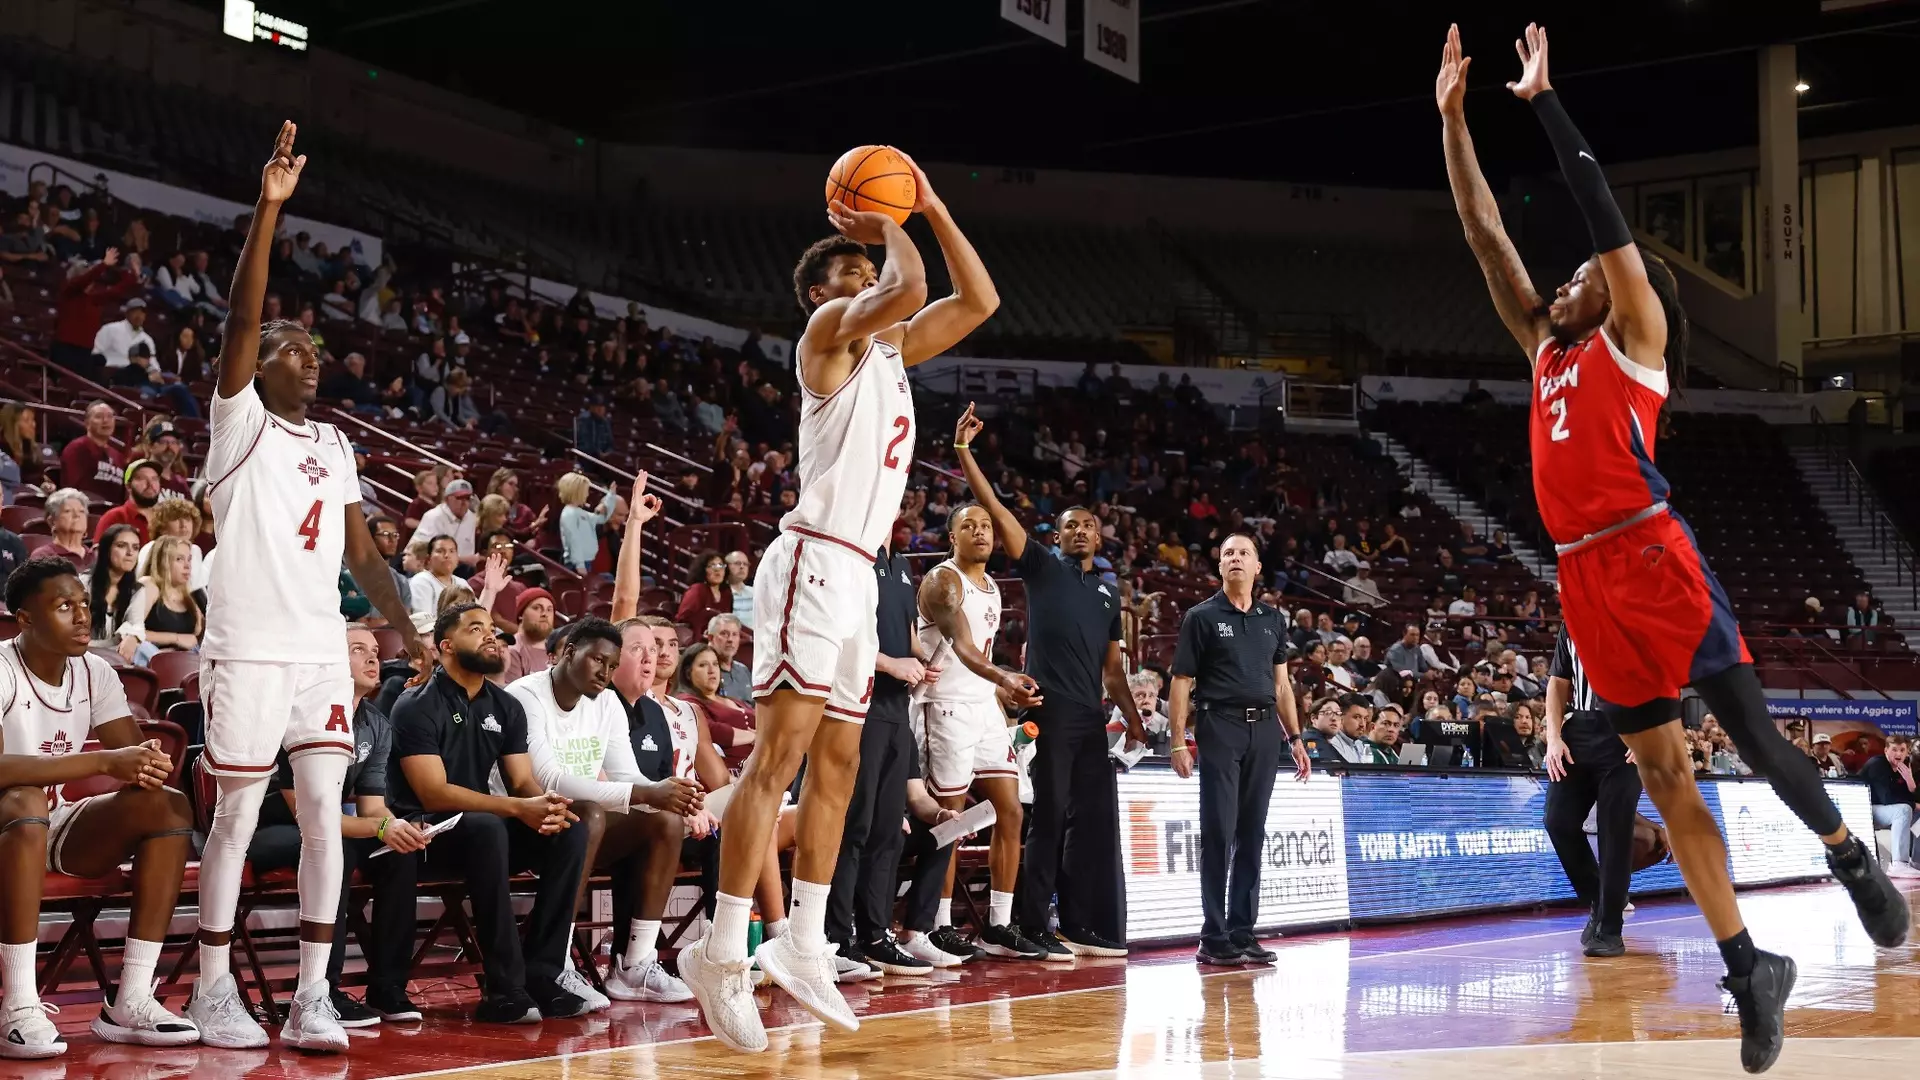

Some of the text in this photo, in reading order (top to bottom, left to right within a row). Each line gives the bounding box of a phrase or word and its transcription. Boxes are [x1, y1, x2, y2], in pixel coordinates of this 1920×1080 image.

[1783, 203, 1793, 260] SOUTH
[1551, 396, 1570, 442] 2
[298, 499, 324, 551] 4
[325, 704, 350, 734] A
[1801, 707, 1813, 716] go
[1815, 704, 1843, 715] where
[1845, 704, 1860, 715] the
[1862, 705, 1893, 717] Aggies
[1895, 706, 1912, 717] go!
[568, 735, 601, 752] KIDS
[573, 763, 593, 777] BE
[1357, 832, 1398, 861] YOUR
[1399, 831, 1451, 859] SAFETY.
[1455, 831, 1490, 857] YOUR
